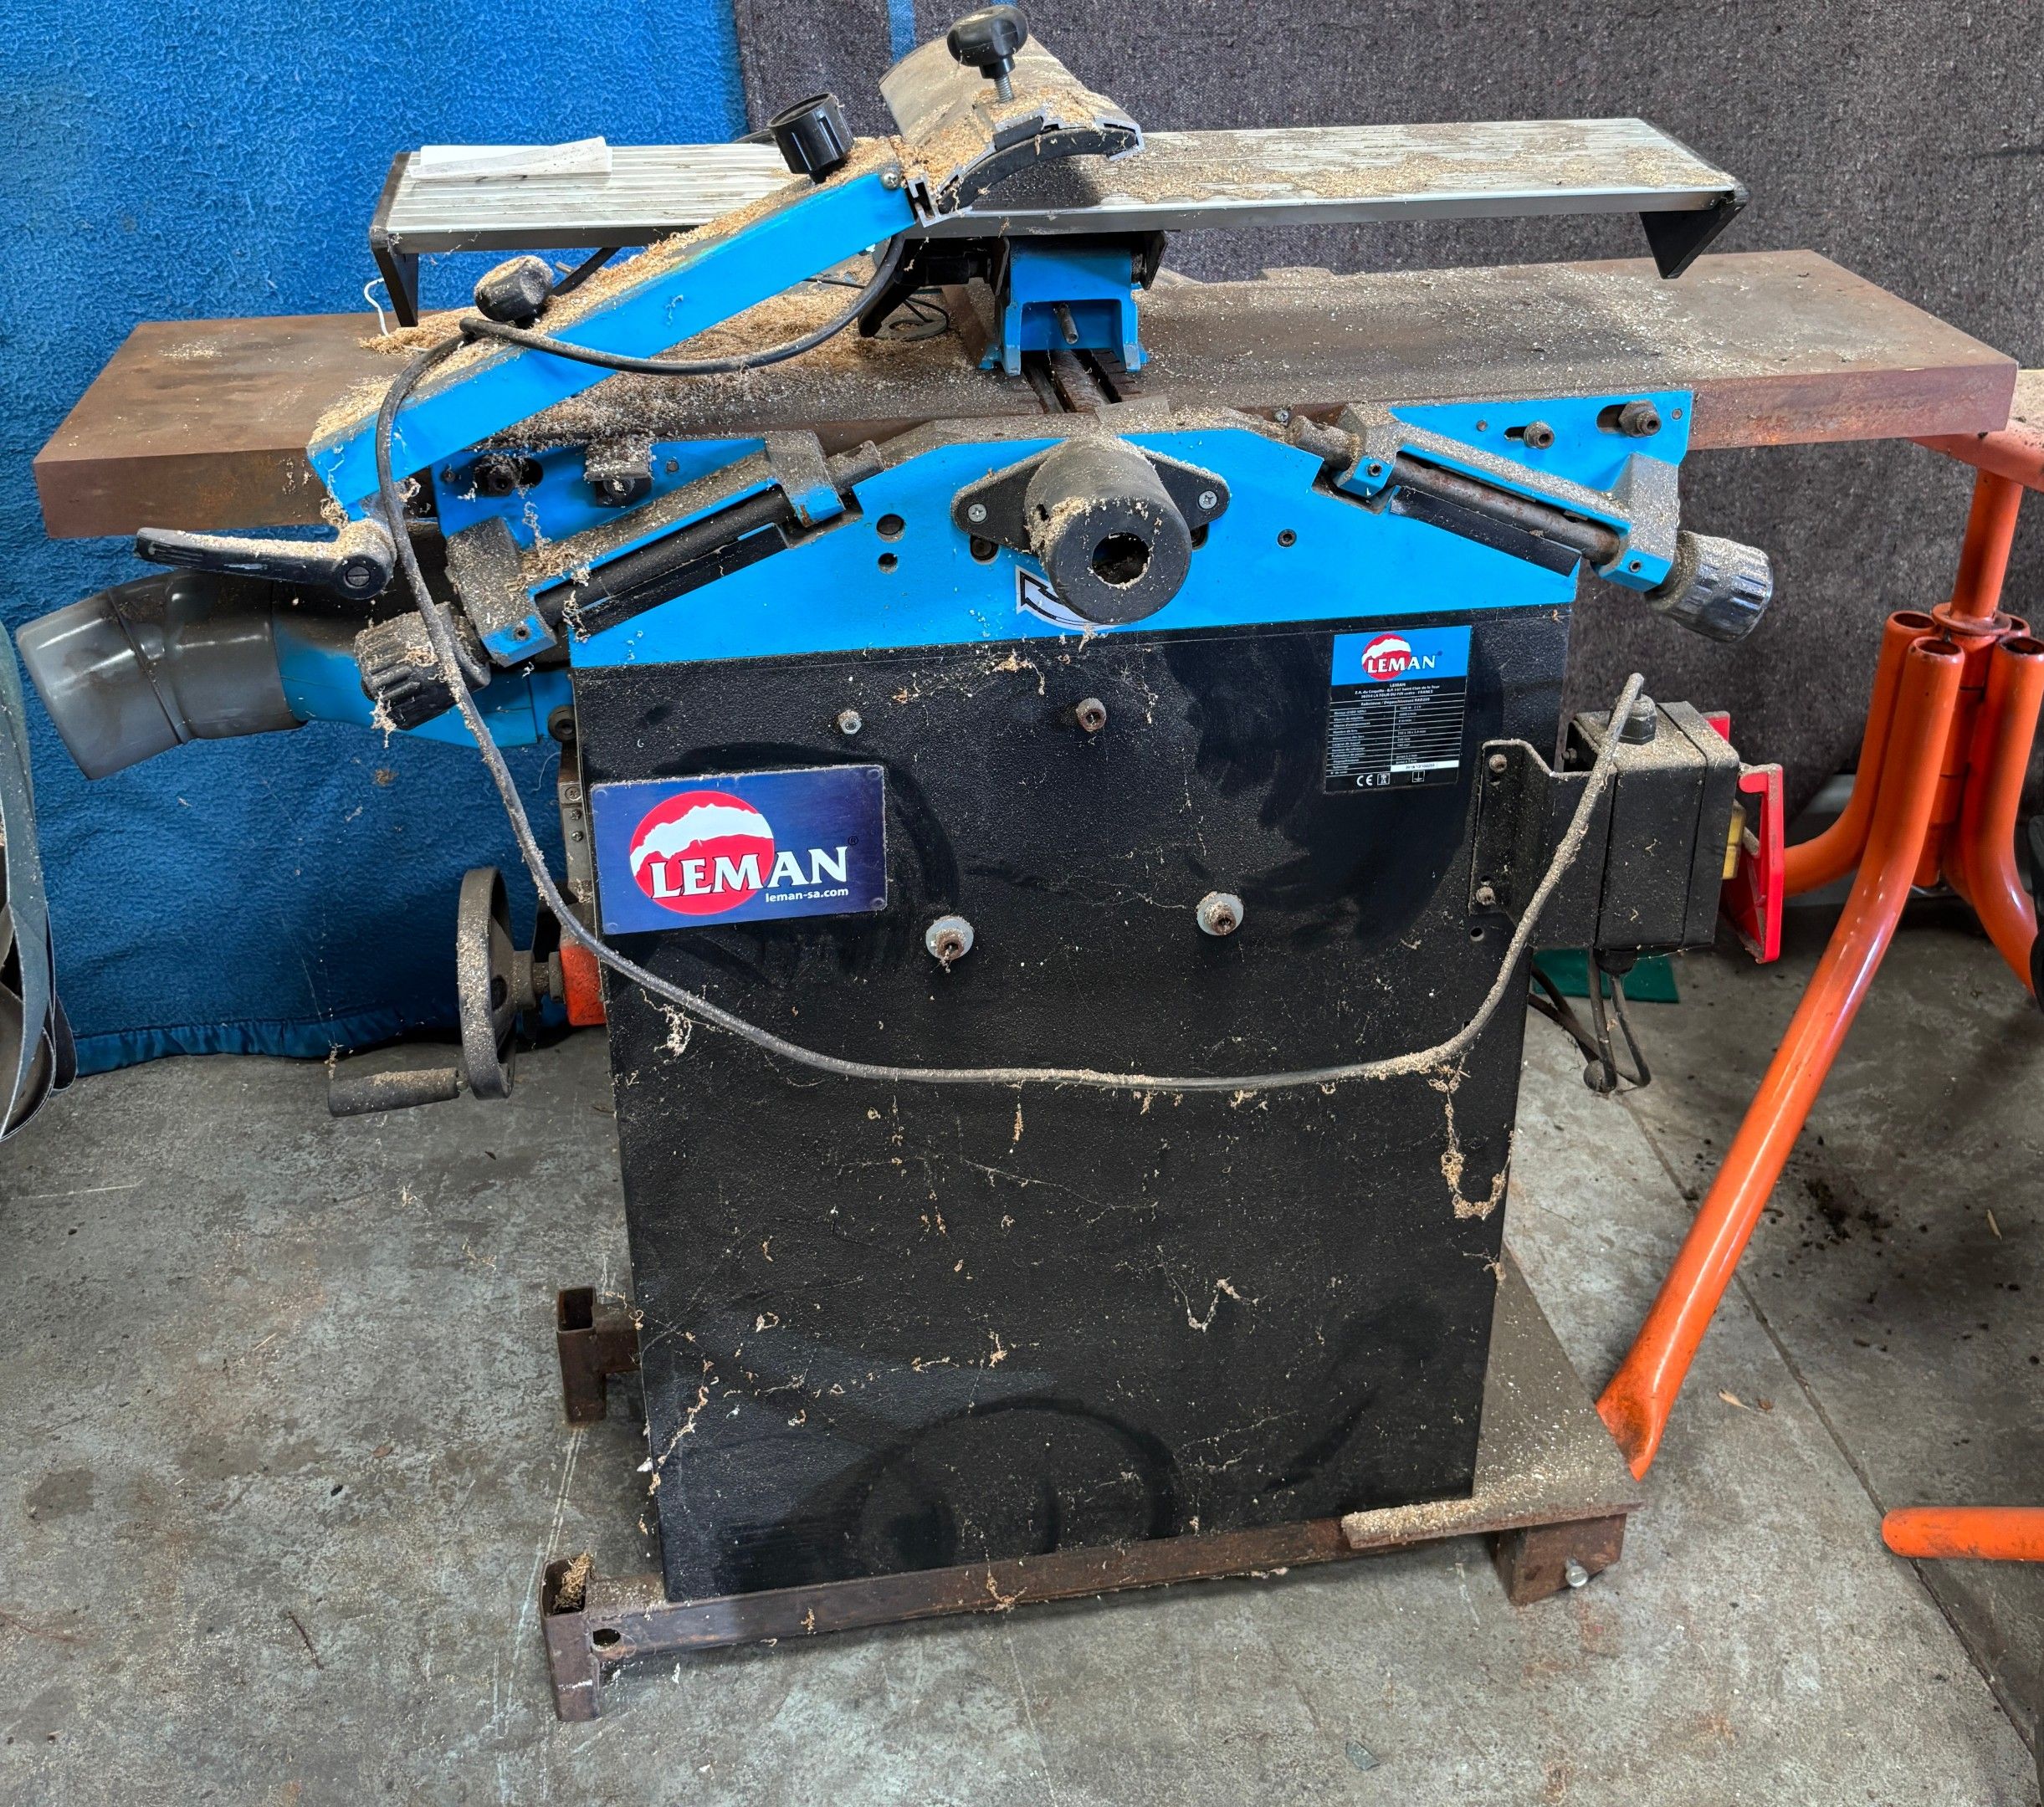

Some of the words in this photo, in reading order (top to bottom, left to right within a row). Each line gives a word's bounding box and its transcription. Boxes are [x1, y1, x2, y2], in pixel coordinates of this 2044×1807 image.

[1367, 655, 1436, 673] LEMAN
[649, 846, 848, 899] LEMAN
[765, 887, 848, 903] leman-sa.com
